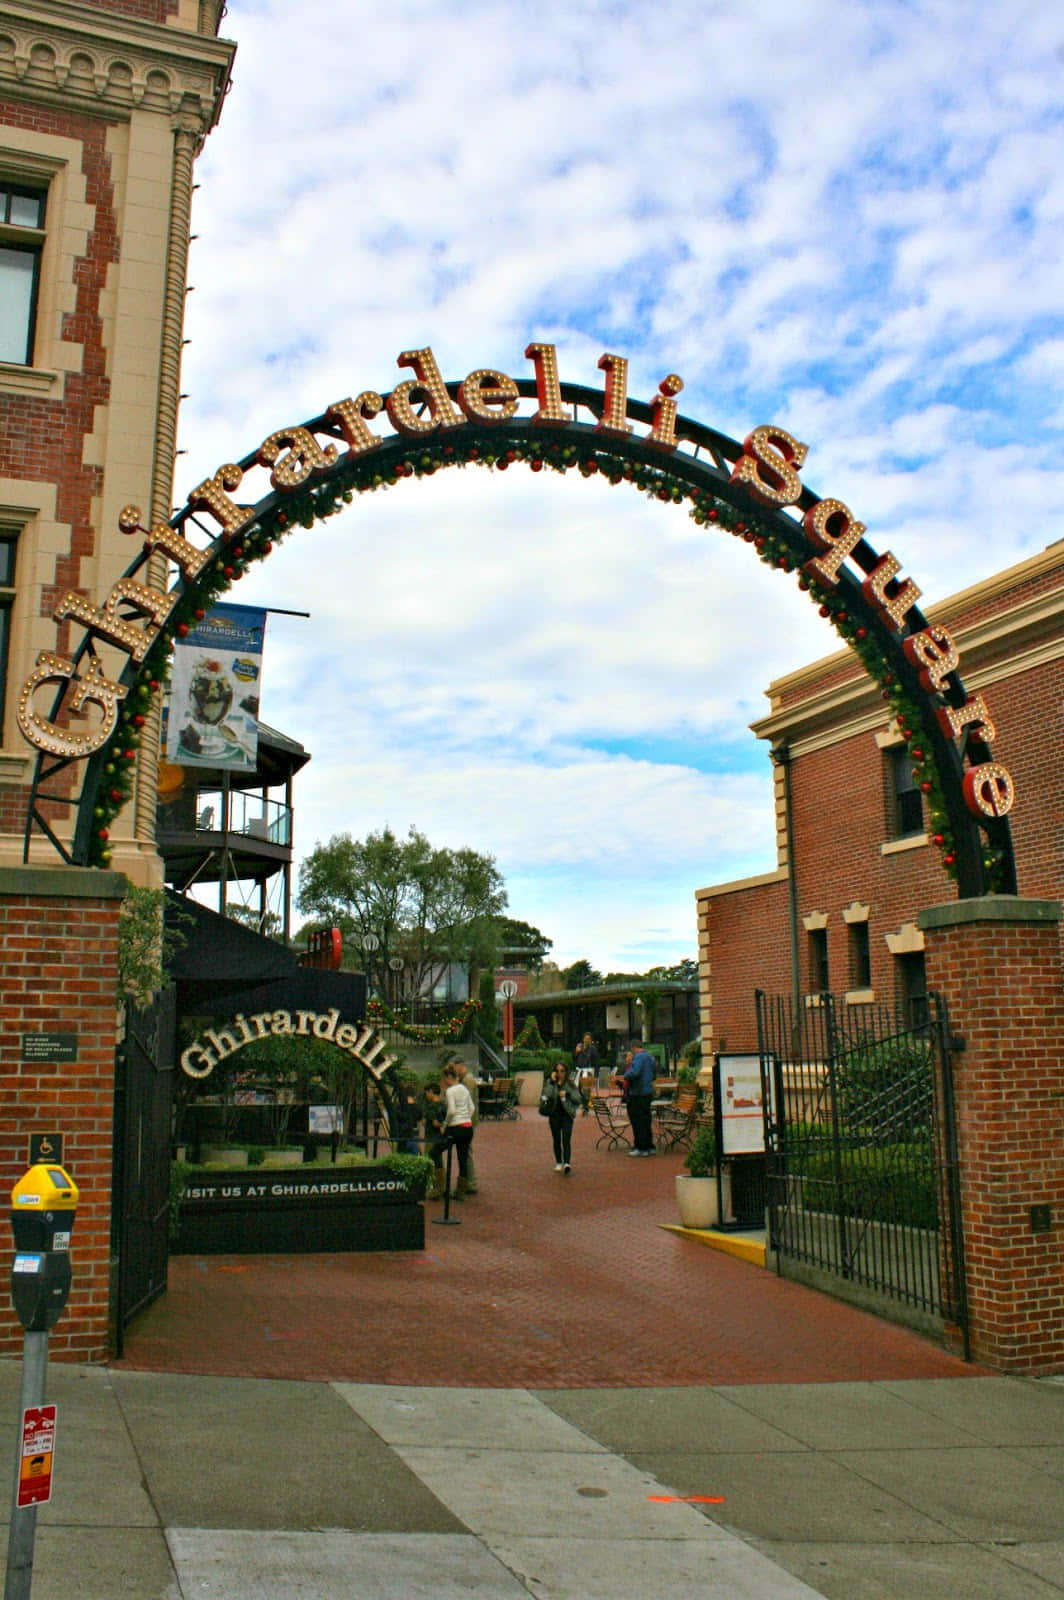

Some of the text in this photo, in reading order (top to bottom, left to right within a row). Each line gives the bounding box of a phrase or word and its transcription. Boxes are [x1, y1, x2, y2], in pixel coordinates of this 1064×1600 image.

[16, 343, 1015, 817] Ghirardelli Square
[181, 1008, 398, 1080] Ghirardelli
[222, 1186, 241, 1197] US
[247, 1186, 267, 1196] AT
